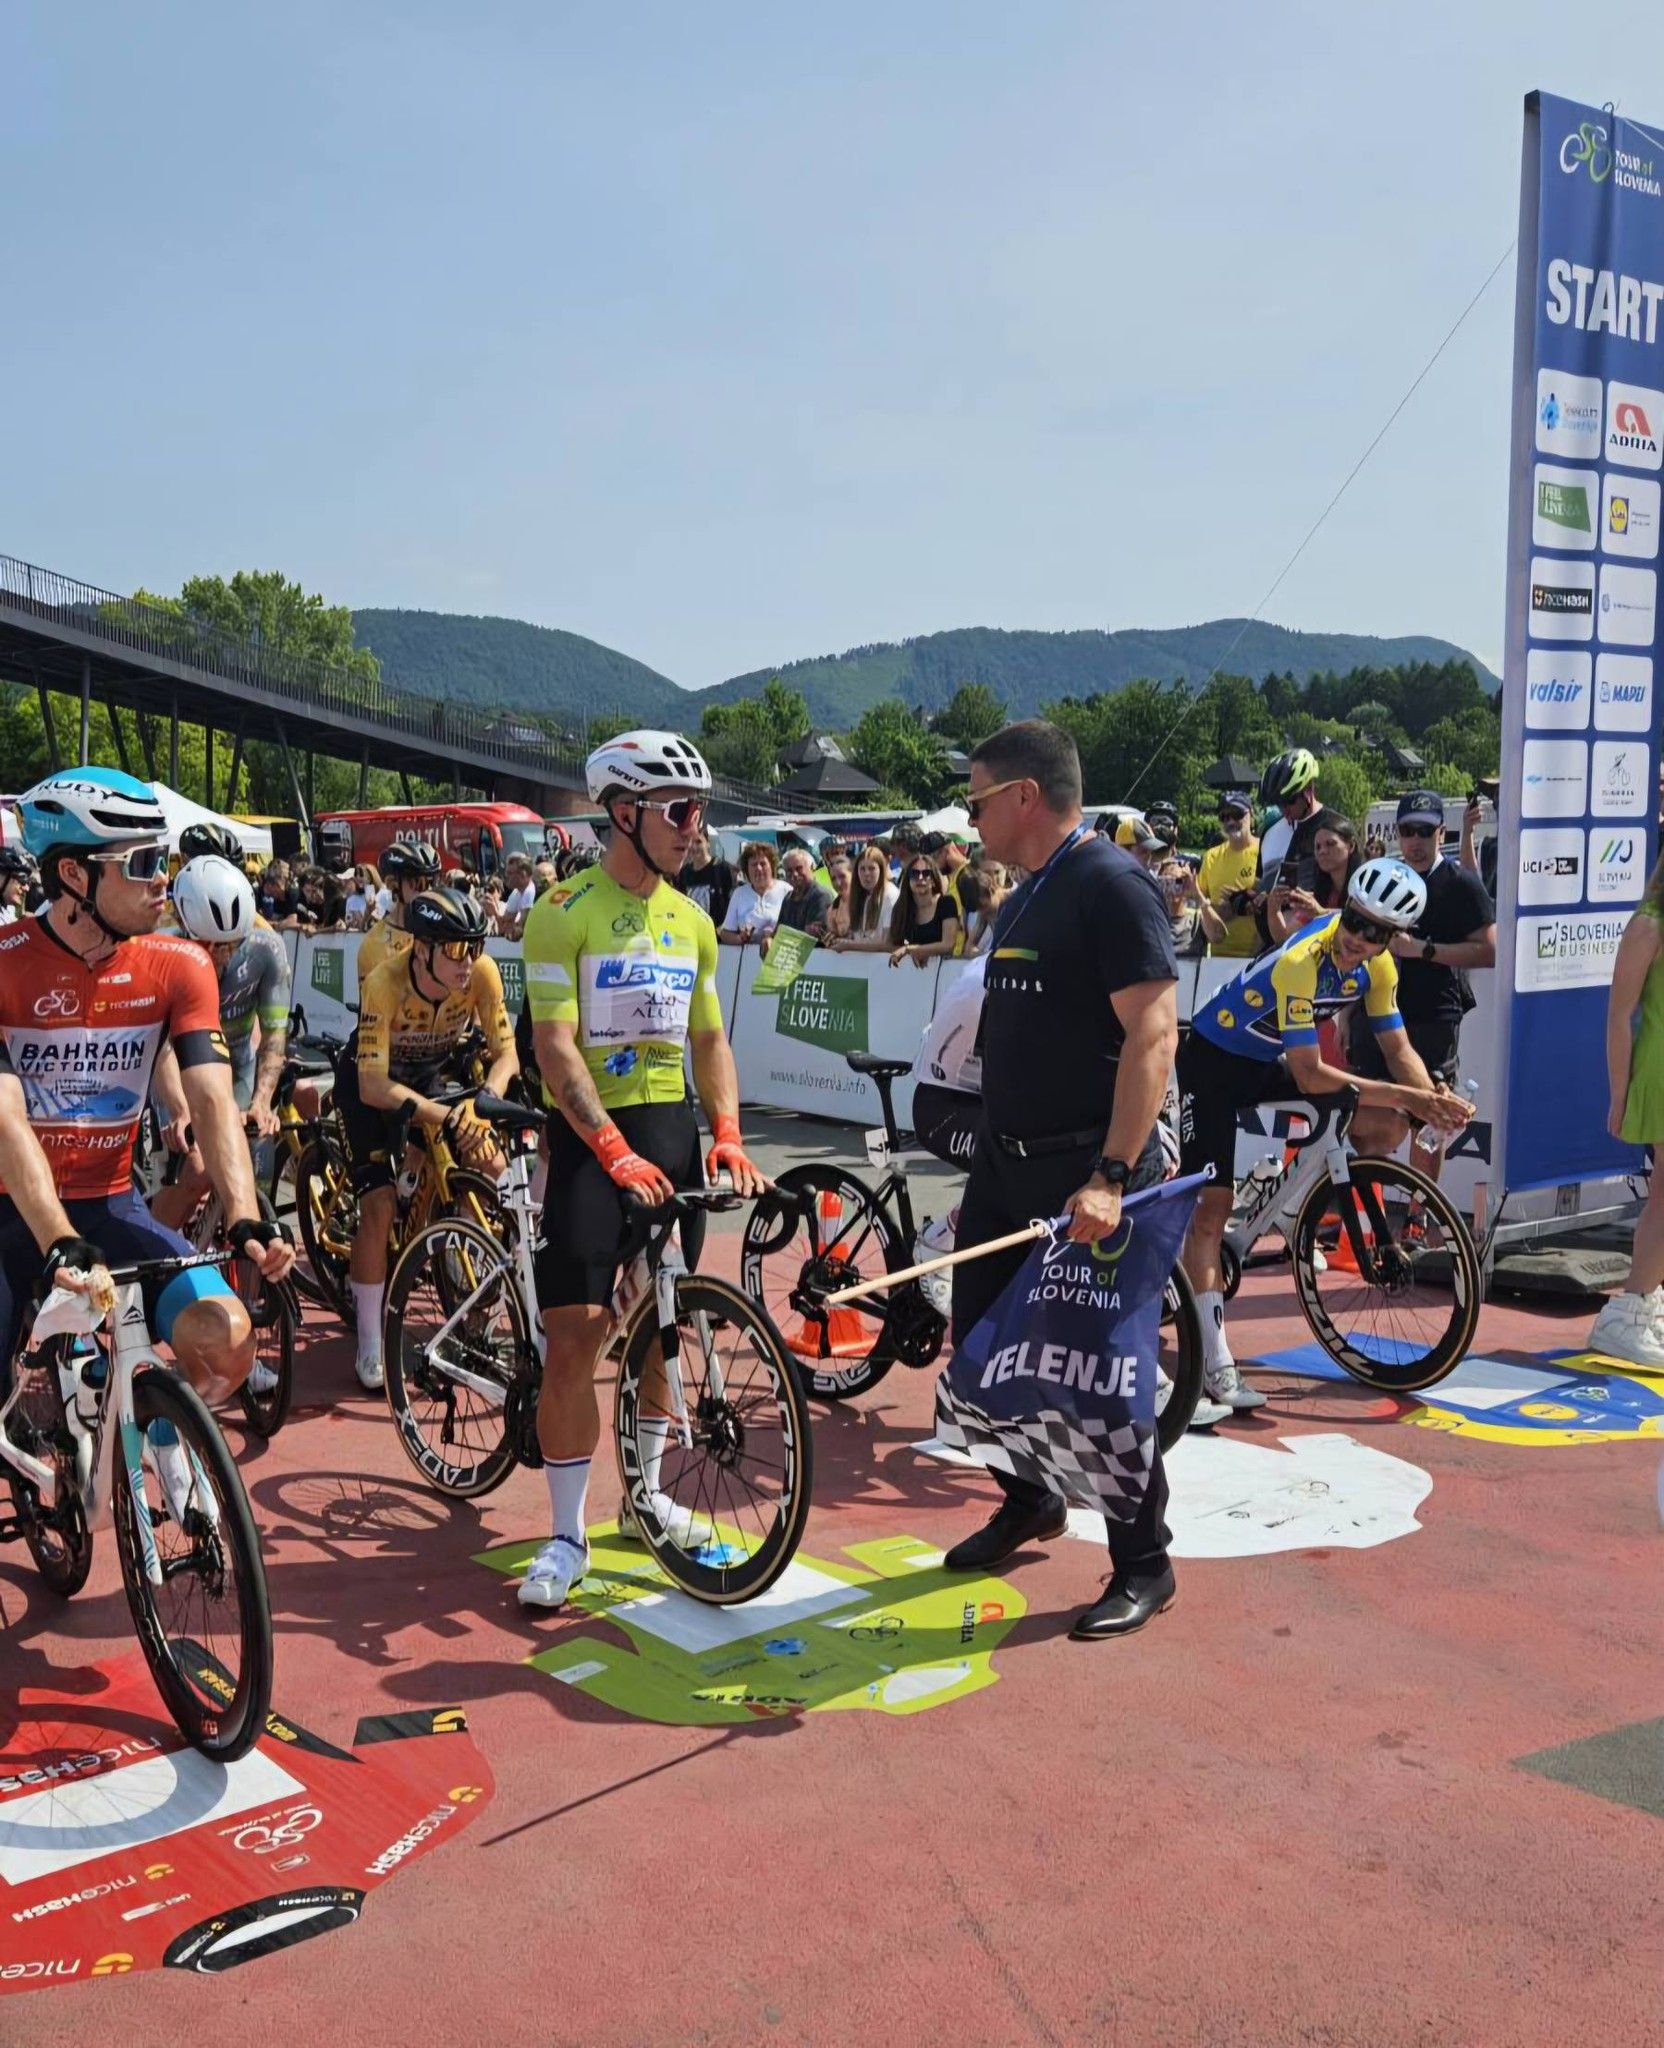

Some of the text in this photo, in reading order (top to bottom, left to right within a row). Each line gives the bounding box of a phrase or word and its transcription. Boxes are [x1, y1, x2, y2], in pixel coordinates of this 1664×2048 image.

[1546, 258, 1664, 344] START
[1530, 678, 1583, 704] valsir
[1612, 685, 1646, 702] MAPEI
[1523, 861, 1542, 874] UCI
[1561, 922, 1624, 942] SLOVENIA
[607, 955, 692, 988] Jayco
[793, 980, 828, 1003] FEEL
[20, 1039, 146, 1061] BAHRAIN
[1041, 1264, 1118, 1287] TOUR of
[1026, 1284, 1122, 1311] SLOVENIA
[979, 1341, 1138, 1398] VELENJE
[0, 1958, 80, 1979] nice
